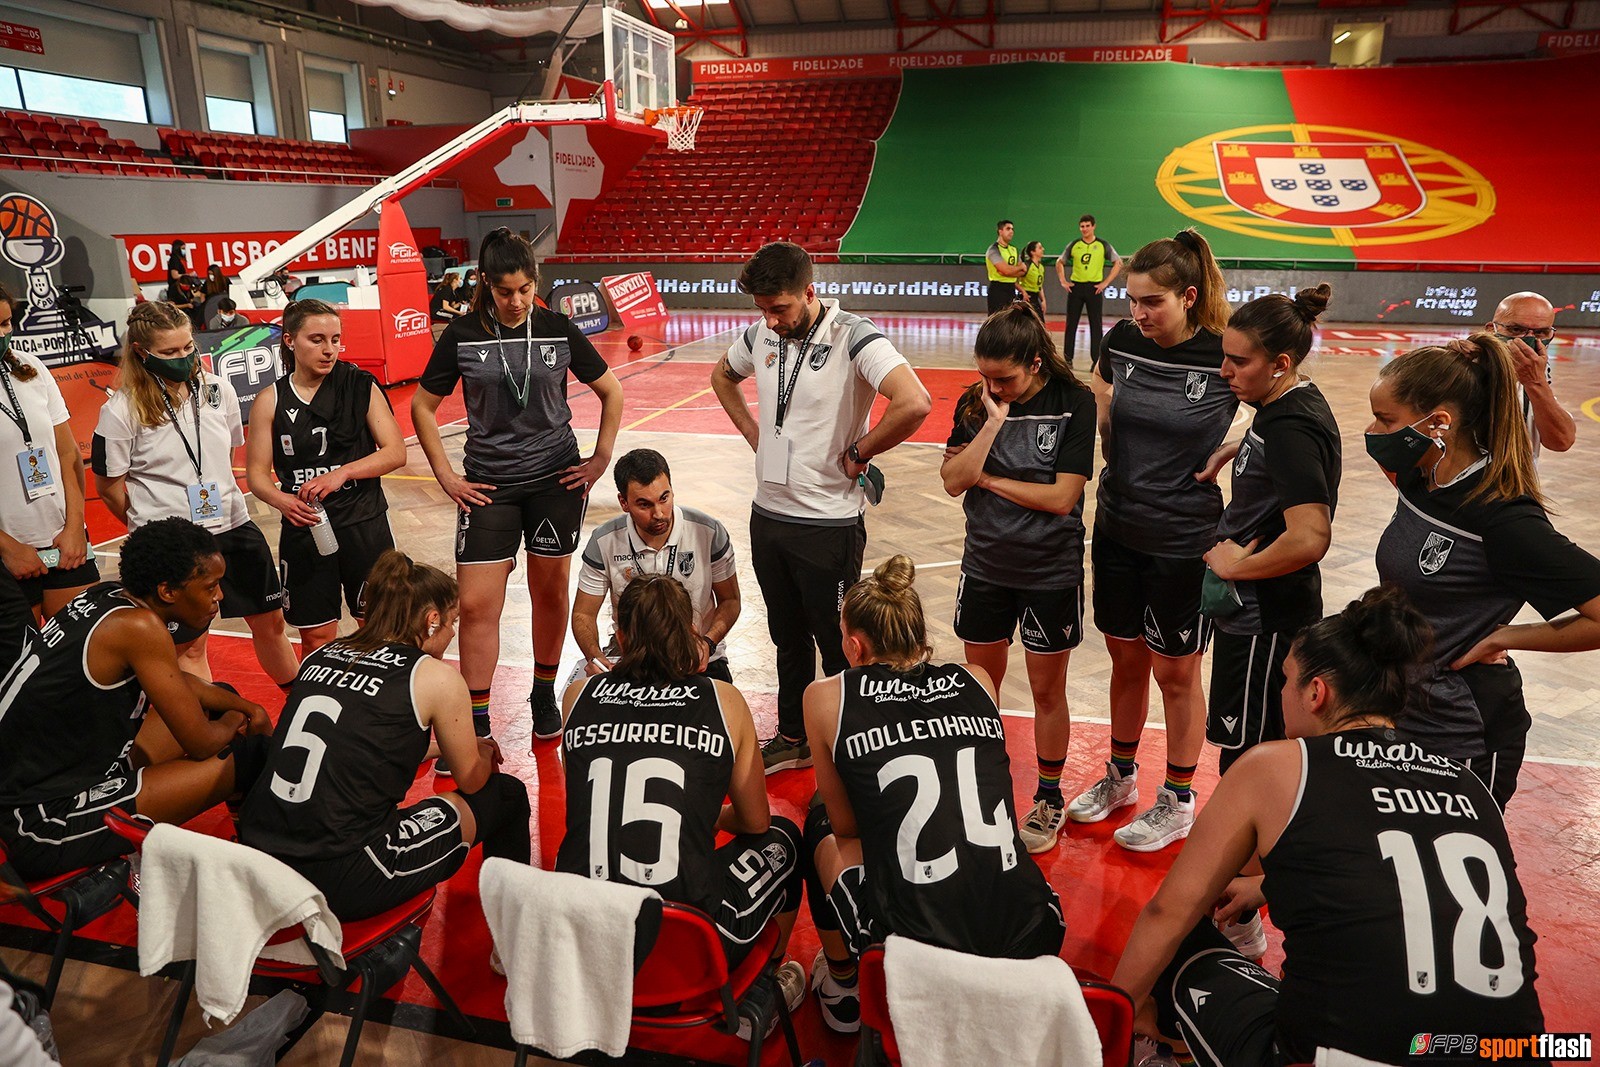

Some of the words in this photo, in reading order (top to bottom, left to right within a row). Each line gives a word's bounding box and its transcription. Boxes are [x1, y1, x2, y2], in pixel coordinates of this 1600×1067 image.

[30, 30, 40, 40] 05
[700, 62, 768, 75] FIDELIDADE
[793, 58, 864, 71] FIDELIDADE
[889, 55, 963, 67] FIDELIDADE
[1093, 49, 1173, 62] FIDELIDADE
[555, 152, 596, 168] FIDELIDADE
[125, 242, 197, 272] ORT
[325, 236, 379, 260] BENF
[36, 297, 54, 308] FPB
[572, 291, 600, 315] FPB
[311, 426, 328, 457] 7
[535, 536, 557, 545] DELTA
[837, 580, 845, 612] macron
[300, 664, 384, 697] MATEUS
[269, 695, 343, 803] 5
[564, 722, 725, 757] RESSURREIÇÃO
[845, 715, 1004, 760] MOLLENHAUER
[876, 746, 1018, 885] 24
[1371, 786, 1479, 821] SOUZA
[587, 757, 685, 886] 15
[1376, 829, 1525, 998] 18
